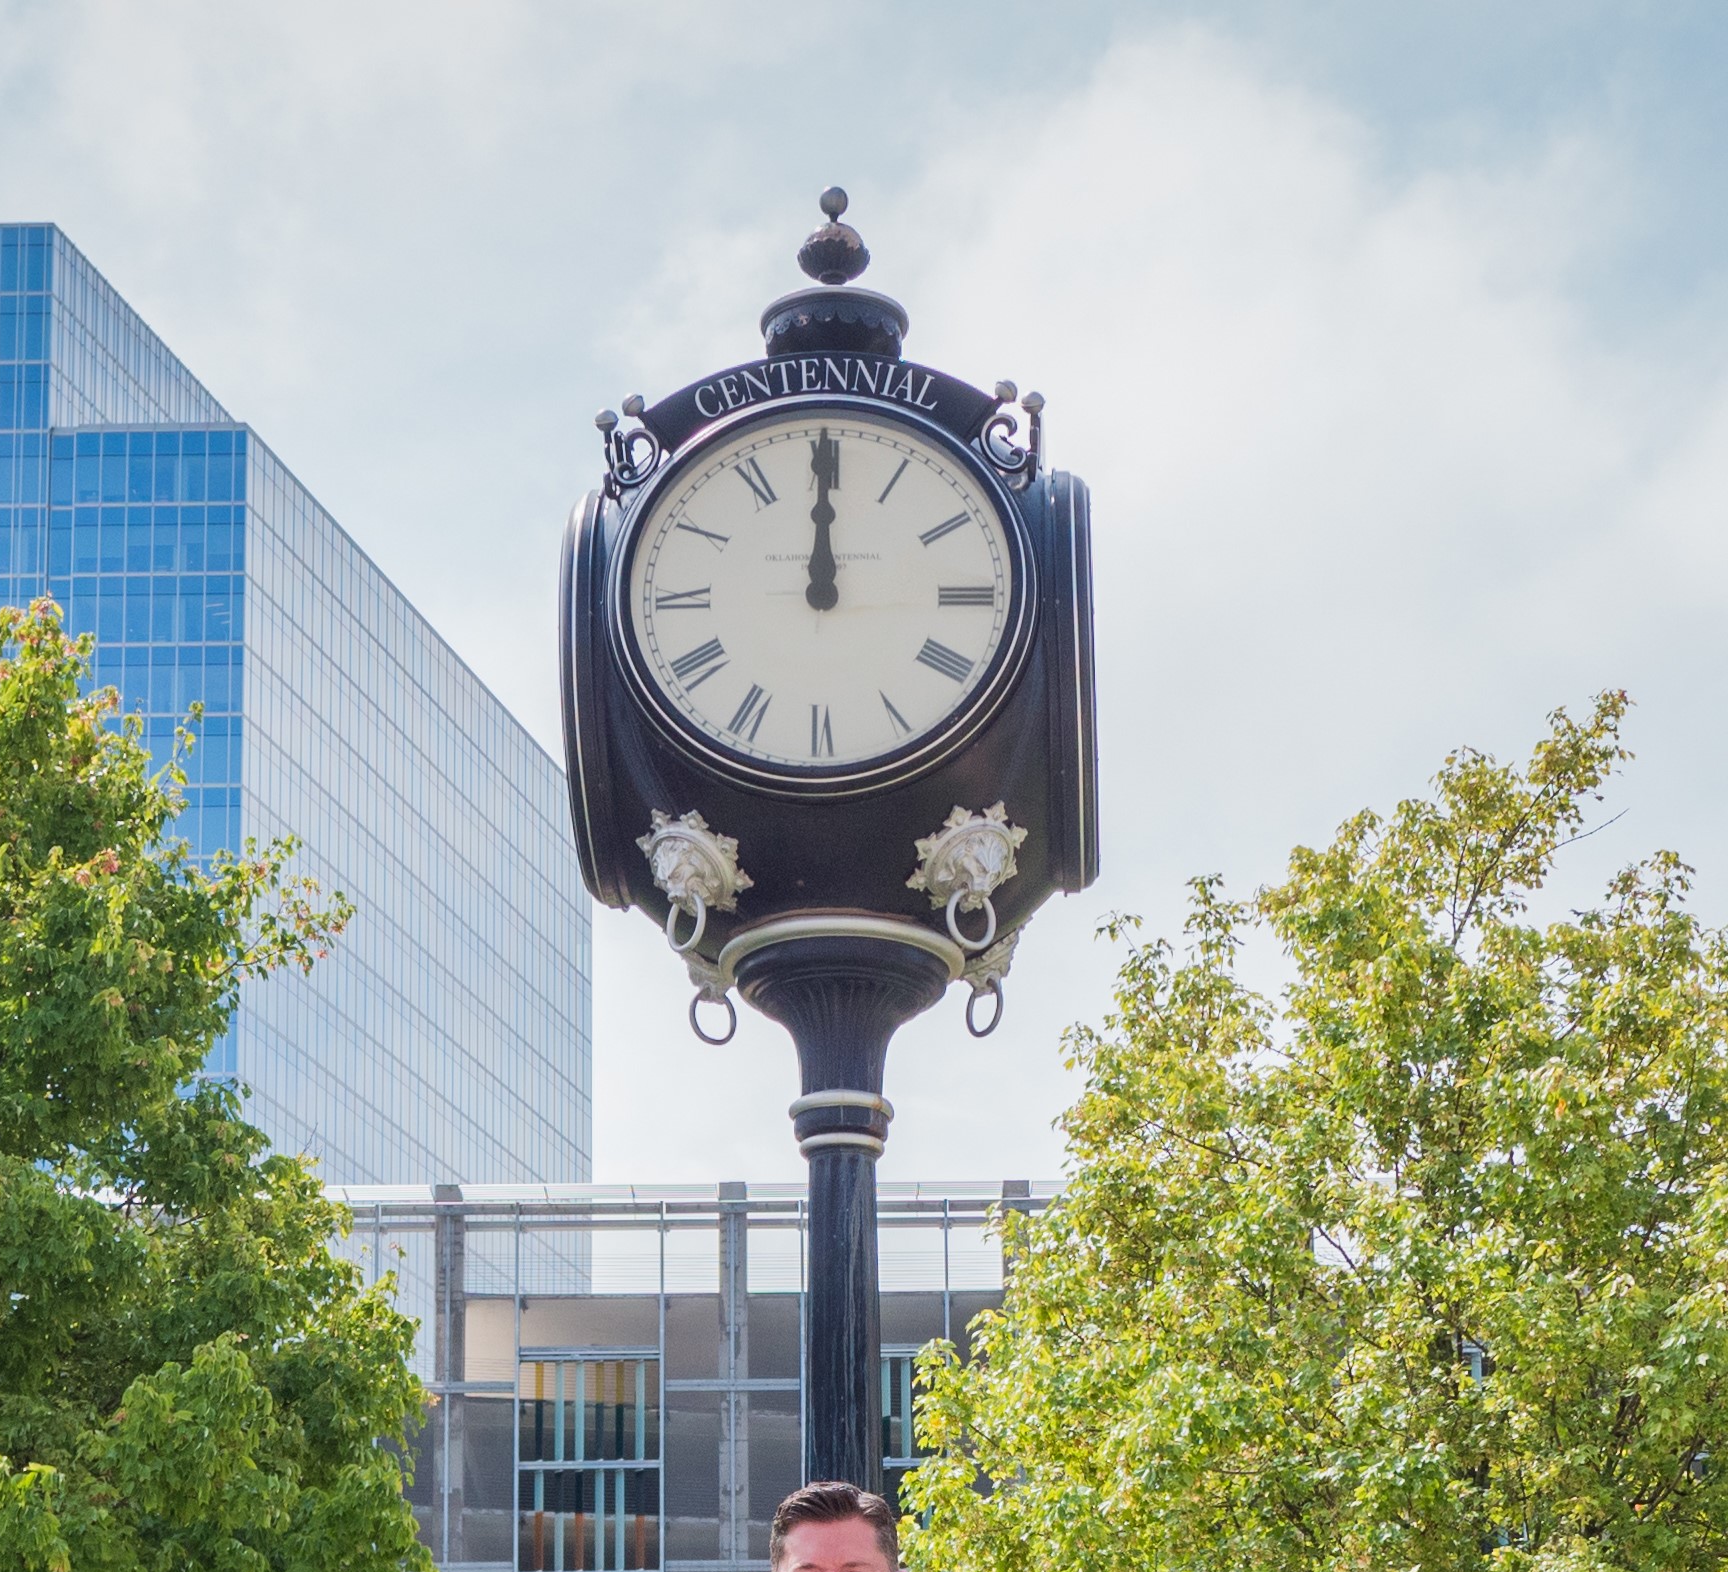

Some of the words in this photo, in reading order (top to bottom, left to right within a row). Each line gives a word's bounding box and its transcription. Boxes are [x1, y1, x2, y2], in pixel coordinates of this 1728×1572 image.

[694, 357, 938, 418] CENTENNIAL
[765, 553, 813, 562] OKLAHO
[833, 552, 882, 561] NTENNIAL
